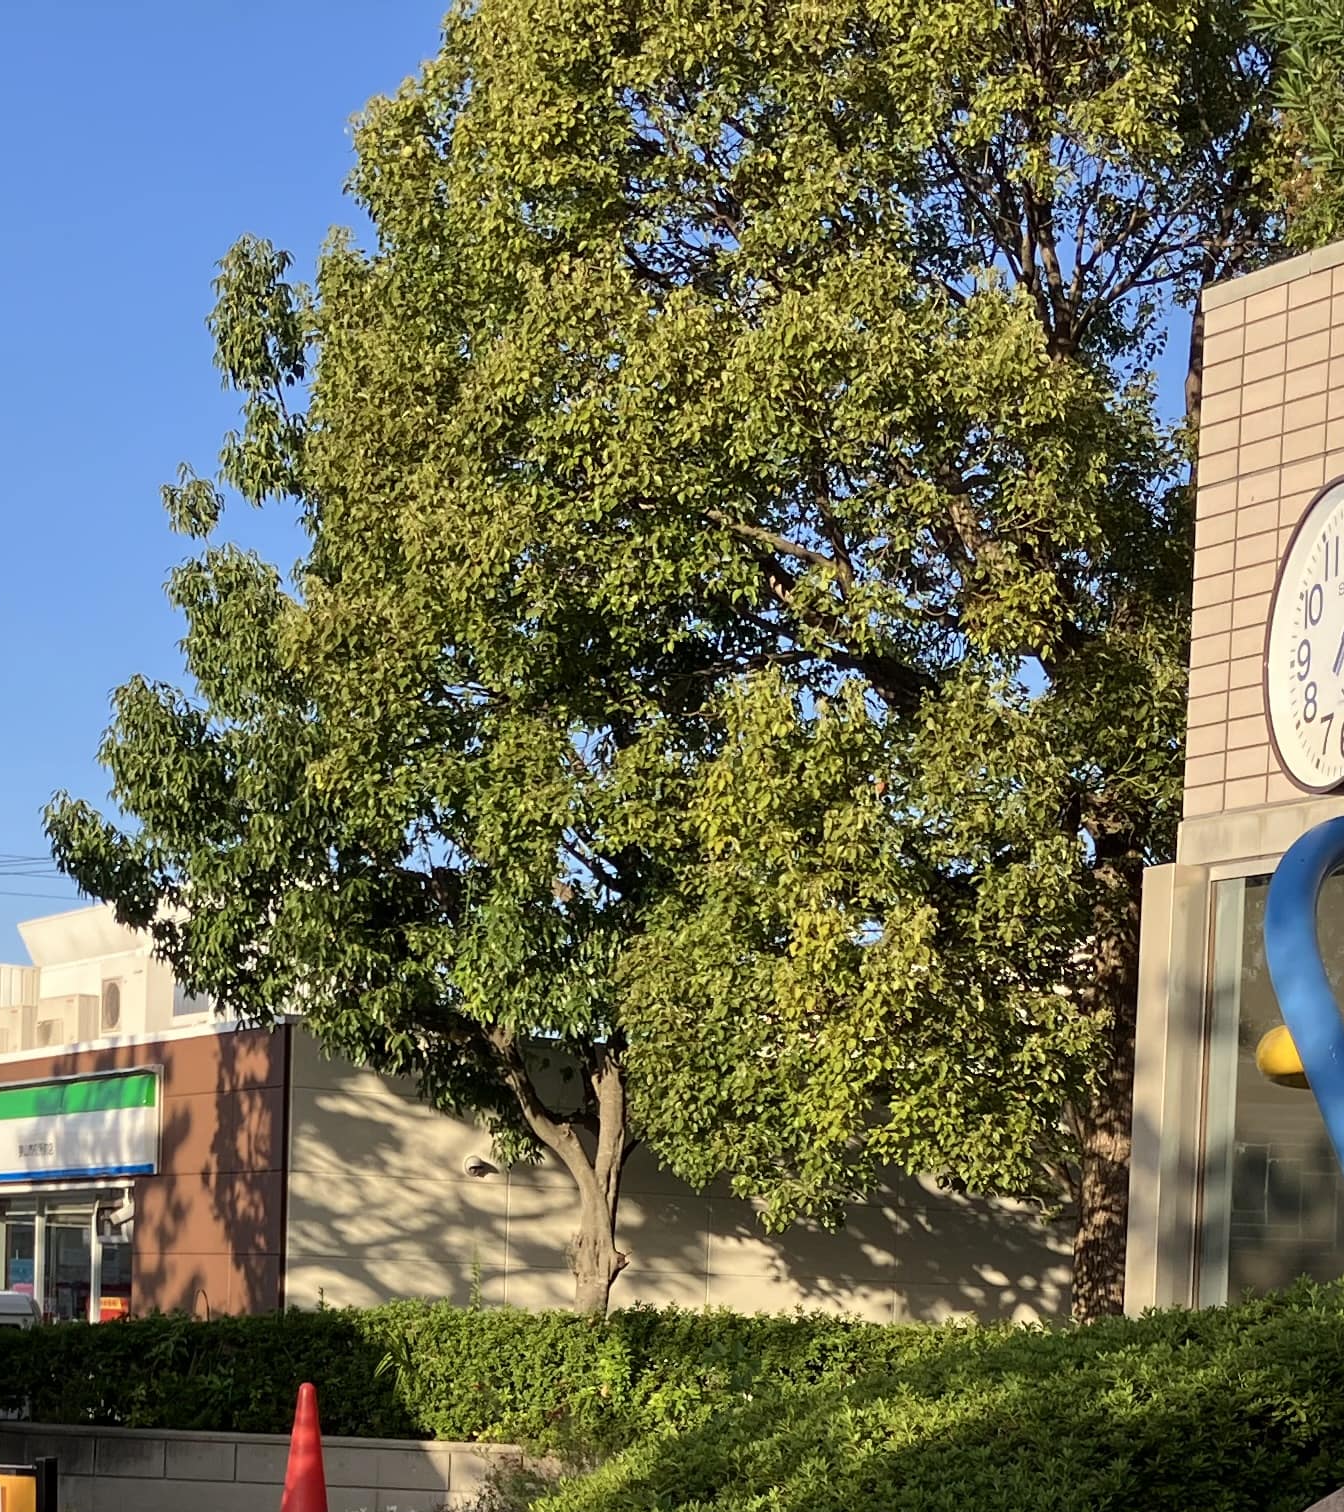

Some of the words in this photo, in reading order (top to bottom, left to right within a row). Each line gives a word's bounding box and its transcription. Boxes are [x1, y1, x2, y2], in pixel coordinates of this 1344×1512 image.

[1324, 535, 1340, 582] 11
[1304, 583, 1324, 630] 10
[1297, 639, 1312, 682] 9
[1304, 681, 1318, 724] 8
[1320, 713, 1335, 756] 7
